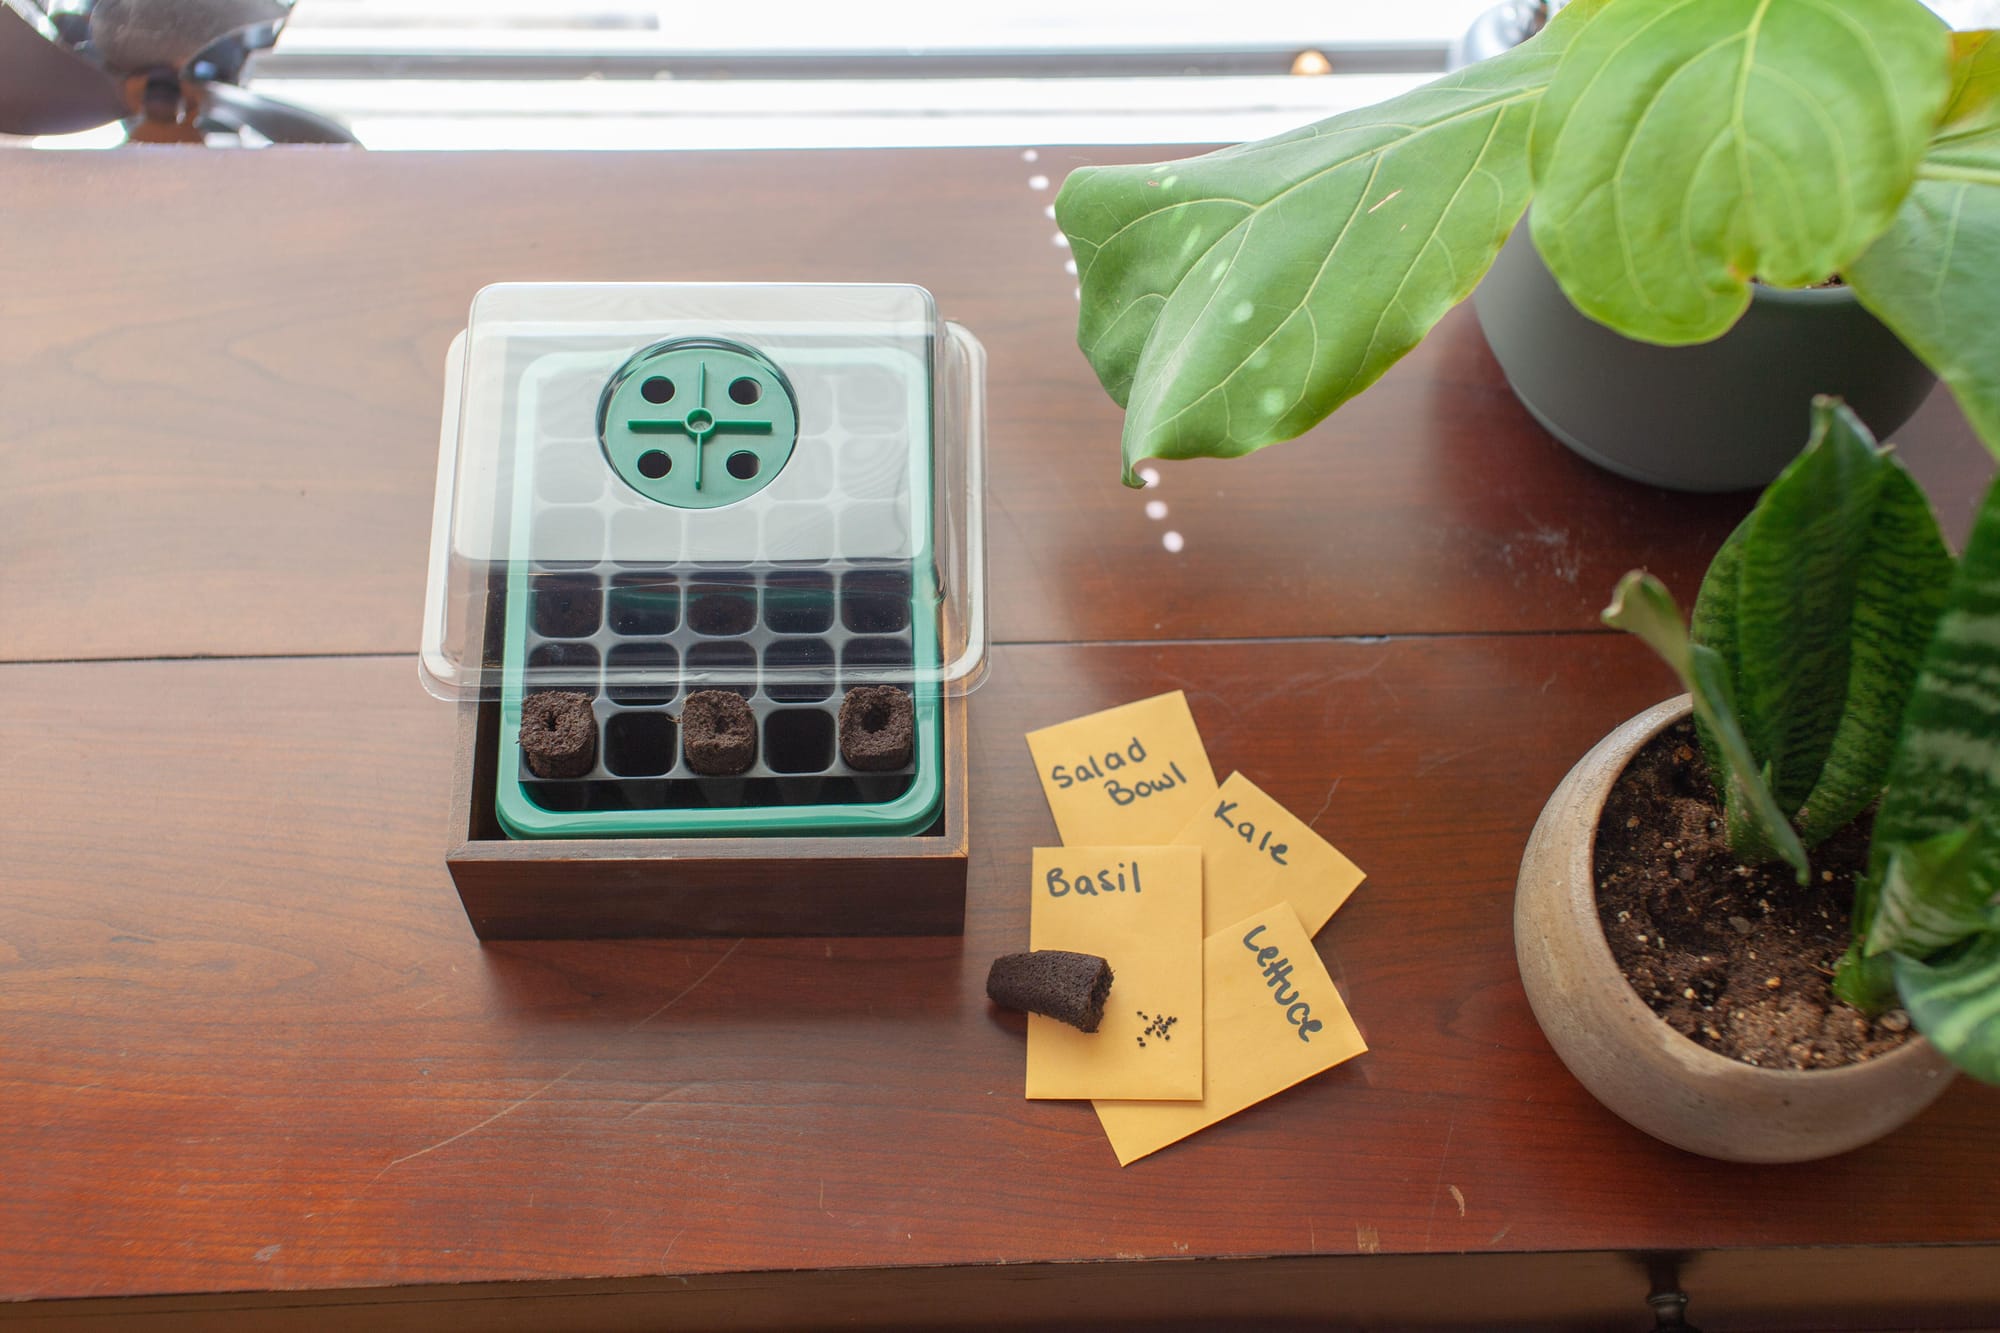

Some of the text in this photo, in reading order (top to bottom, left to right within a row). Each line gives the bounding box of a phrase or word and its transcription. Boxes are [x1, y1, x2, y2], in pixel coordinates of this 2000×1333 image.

[1052, 737, 1147, 789] Salad
[1104, 762, 1187, 806] Bowl
[1214, 800, 1289, 866] Kale
[1046, 862, 1142, 898] Basil
[1243, 925, 1323, 1043] Lettuce
